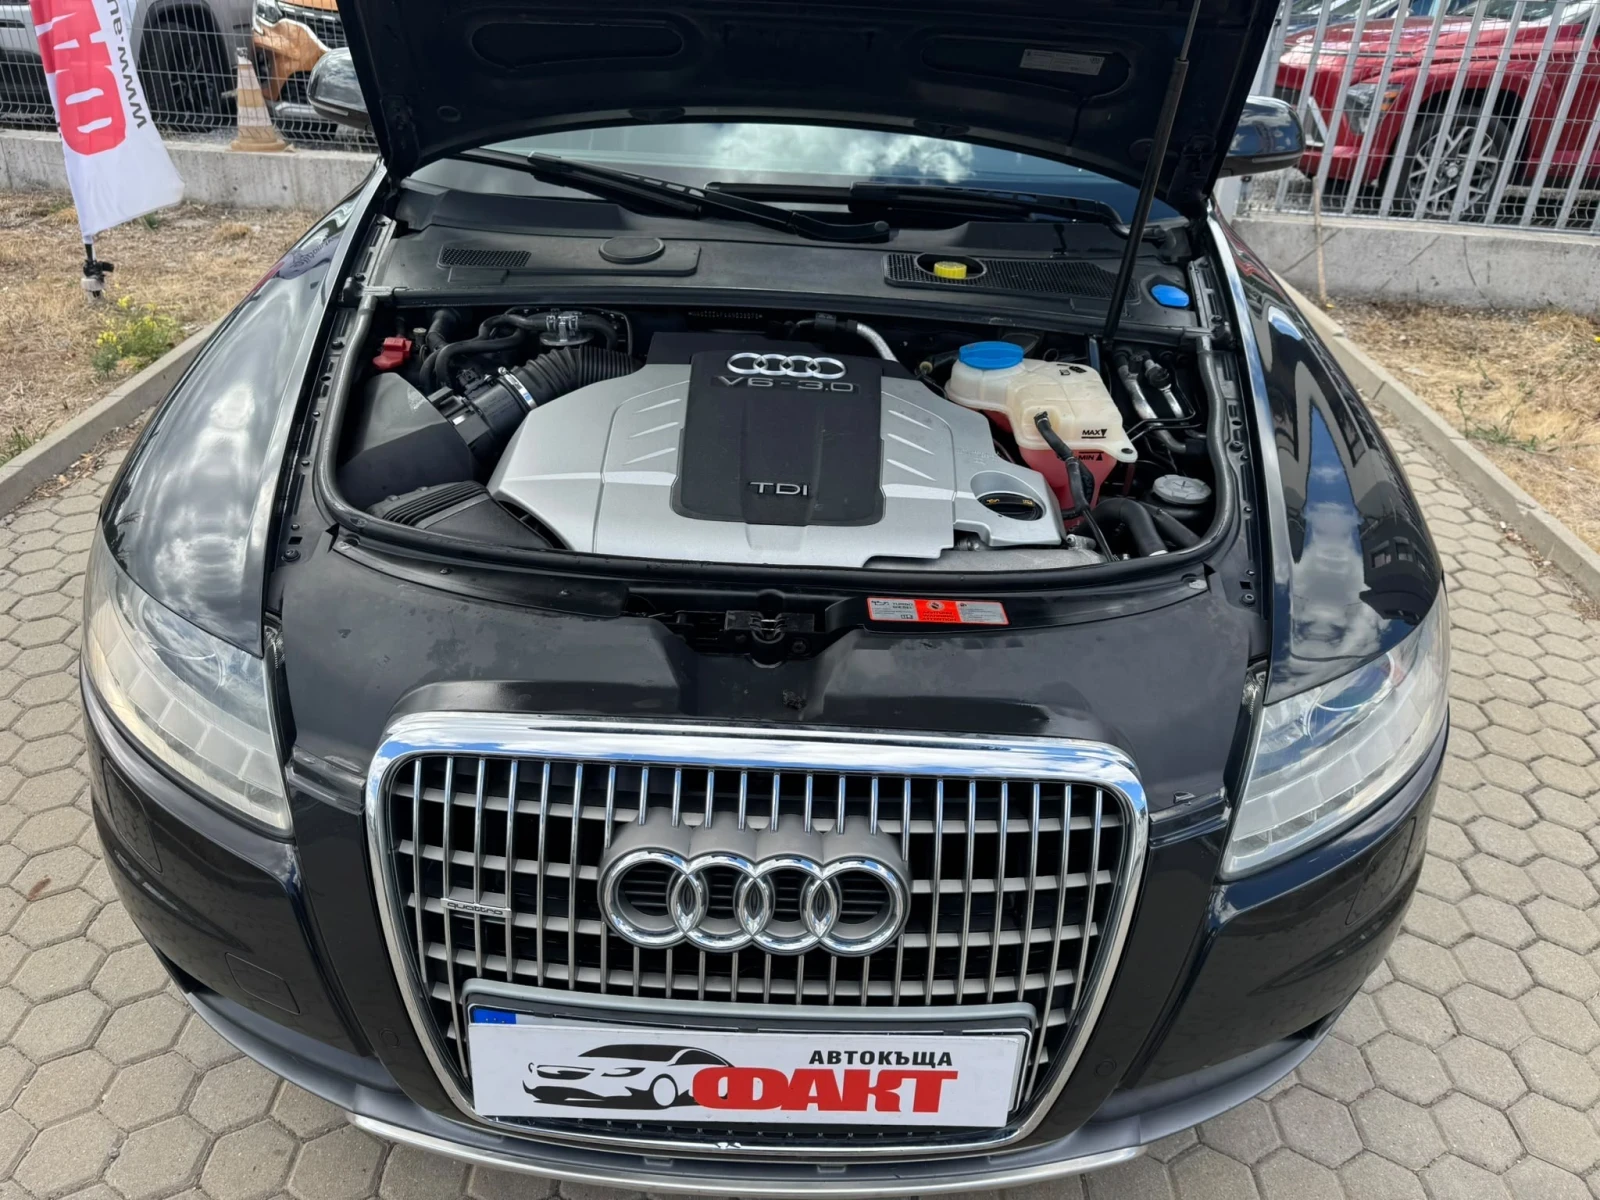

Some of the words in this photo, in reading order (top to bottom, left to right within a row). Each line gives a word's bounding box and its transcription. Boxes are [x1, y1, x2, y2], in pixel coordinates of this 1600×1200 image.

[749, 482, 808, 496] TDI
[447, 902, 504, 916] quattro
[808, 1050, 953, 1069] АВТОКЪЩА
[692, 1066, 959, 1113] ФАКТ
